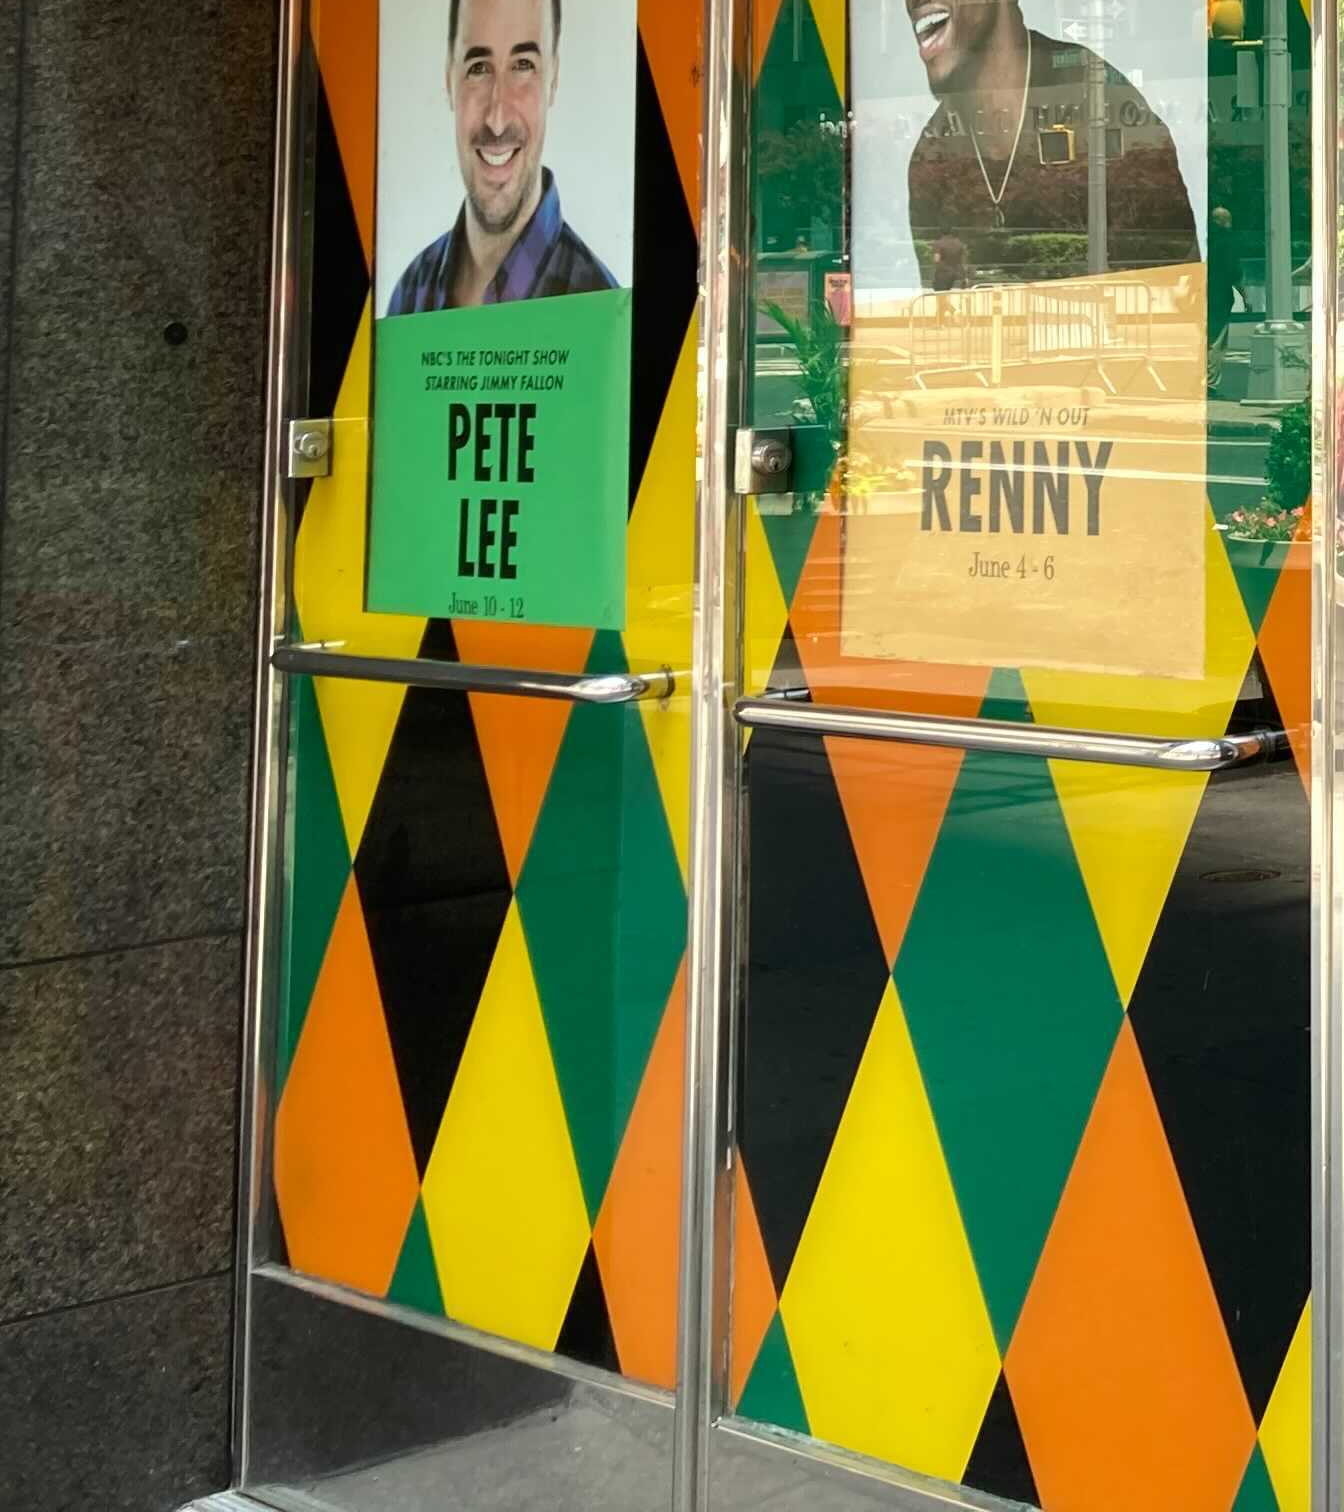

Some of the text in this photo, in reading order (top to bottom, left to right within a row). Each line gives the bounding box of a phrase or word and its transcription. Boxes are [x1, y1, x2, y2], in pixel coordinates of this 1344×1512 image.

[421, 349, 570, 367] NBC'S THE TONIGHT SHOW
[425, 375, 564, 391] STARRING JIMMY FALLON
[943, 407, 987, 426] MTV'S
[993, 407, 1030, 426] WILD
[1057, 407, 1090, 426] OUT
[448, 403, 536, 483] PETE
[920, 440, 1114, 536] RENNY
[458, 498, 519, 579] LEE
[968, 551, 1010, 578] June
[1015, 553, 1026, 579] 4
[1043, 555, 1055, 580] 6
[448, 592, 478, 615] June
[483, 595, 497, 617] 10
[510, 597, 525, 619] 12
